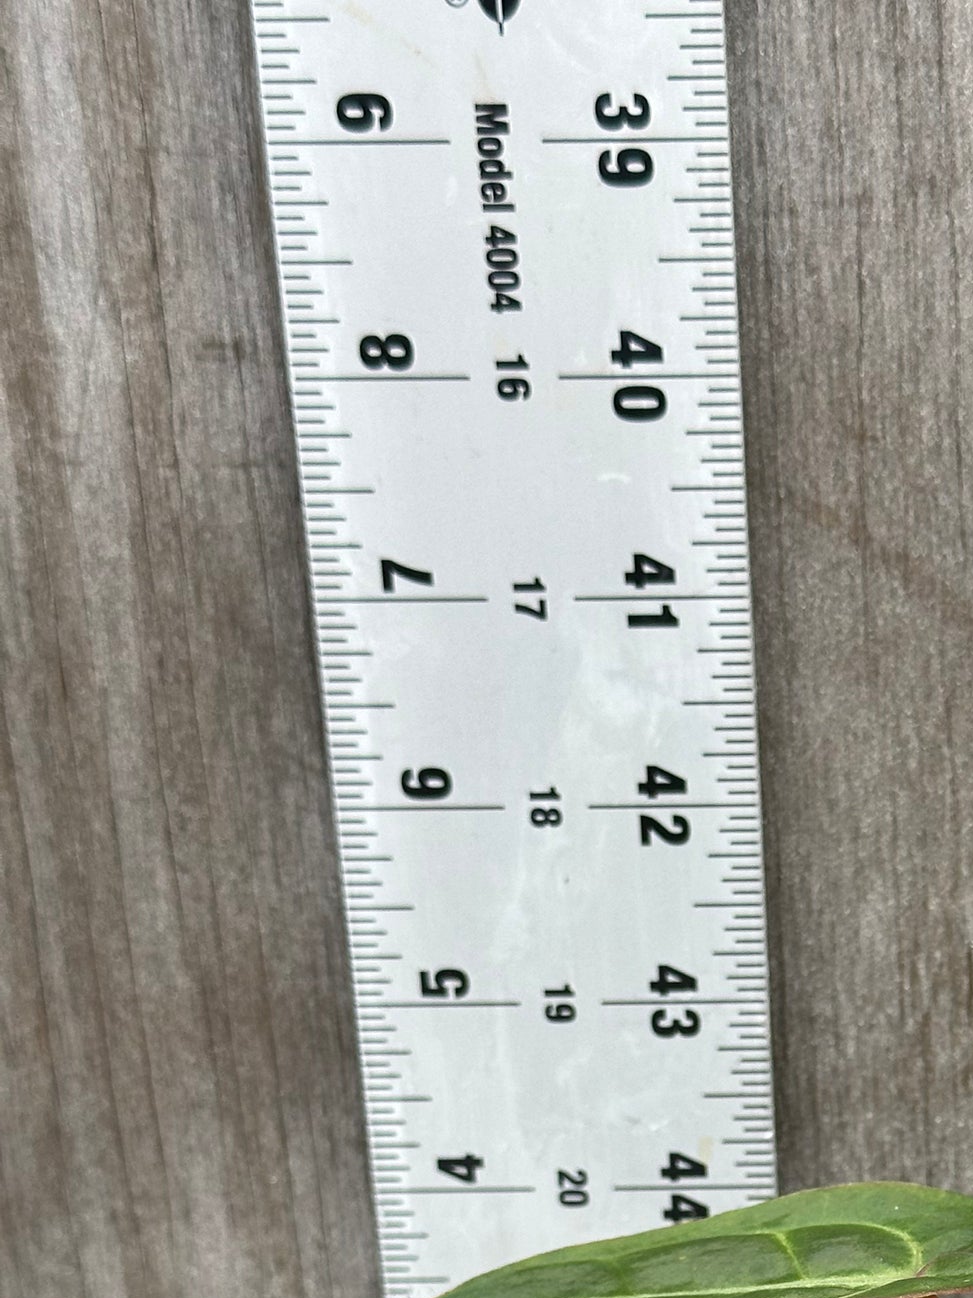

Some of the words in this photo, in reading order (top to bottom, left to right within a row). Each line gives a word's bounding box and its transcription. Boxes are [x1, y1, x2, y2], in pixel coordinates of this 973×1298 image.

[473, 102, 517, 214] Model
[593, 92, 655, 189] 39
[485, 225, 522, 314] 4004
[358, 332, 414, 371] 8
[609, 329, 668, 423] 40
[494, 353, 532, 403] 16
[379, 558, 434, 592] 7
[511, 575, 548, 621] 17
[623, 552, 680, 629] 41
[528, 785, 563, 828] 18
[636, 764, 691, 847] 42
[419, 968, 469, 999] 5
[543, 983, 576, 1023] 19
[648, 964, 702, 1039] 43
[436, 1153, 485, 1182] 4
[557, 1169, 589, 1207] 20
[660, 1152, 710, 1224] 44
